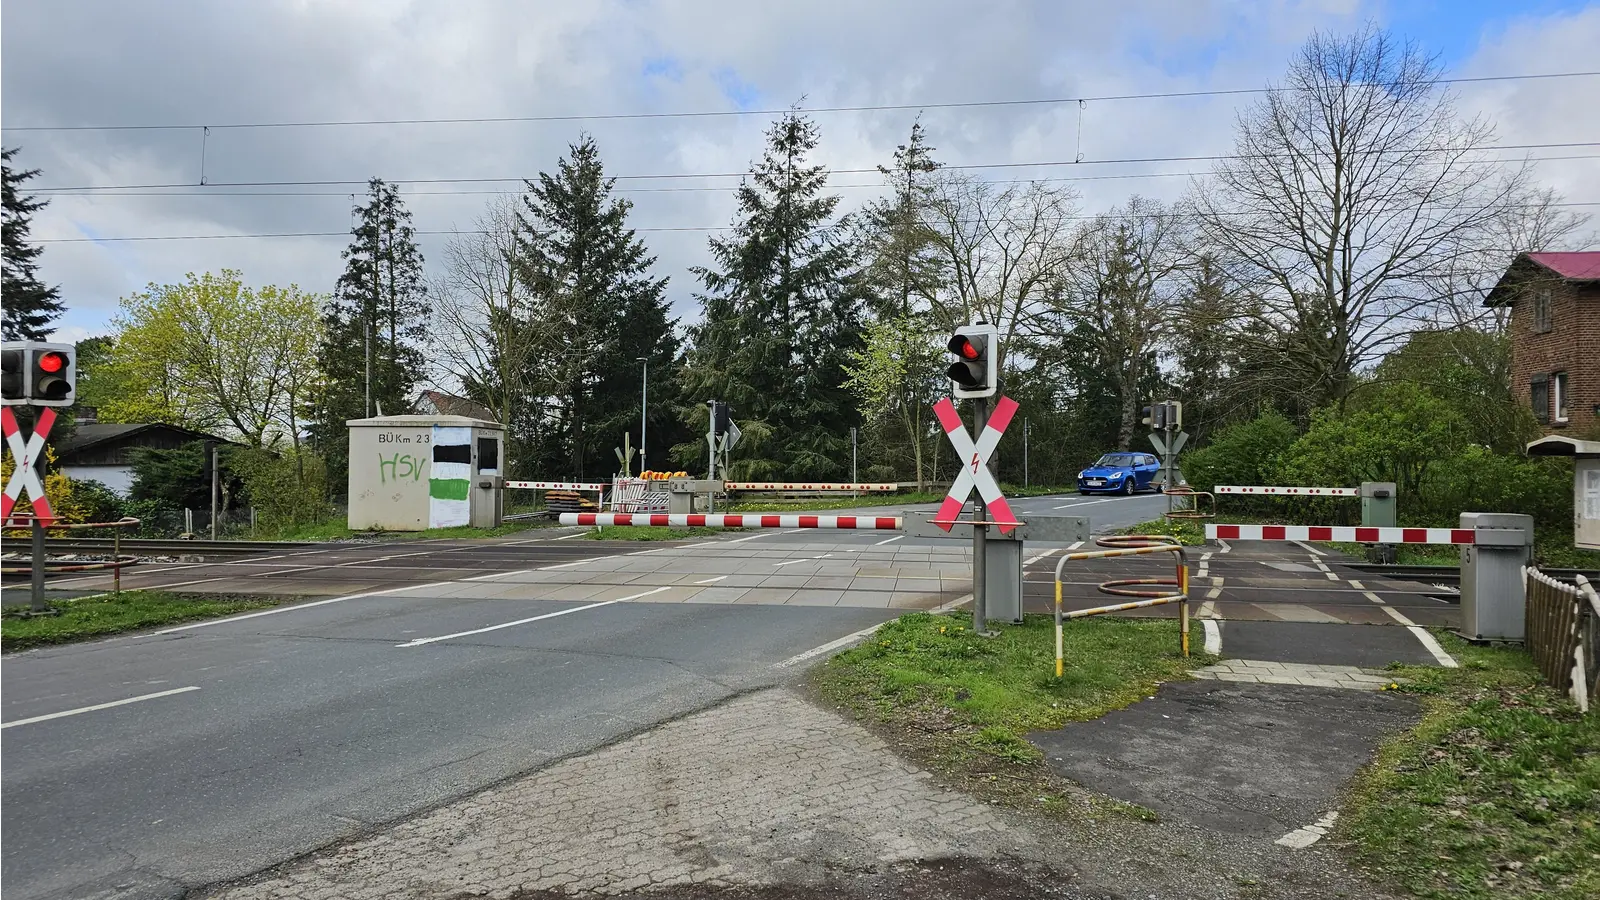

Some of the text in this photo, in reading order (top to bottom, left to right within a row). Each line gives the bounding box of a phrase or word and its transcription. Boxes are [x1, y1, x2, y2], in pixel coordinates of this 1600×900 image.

[416, 434, 430, 444] 23
[378, 452, 426, 484] HSV
[1466, 547, 1471, 564] 5
